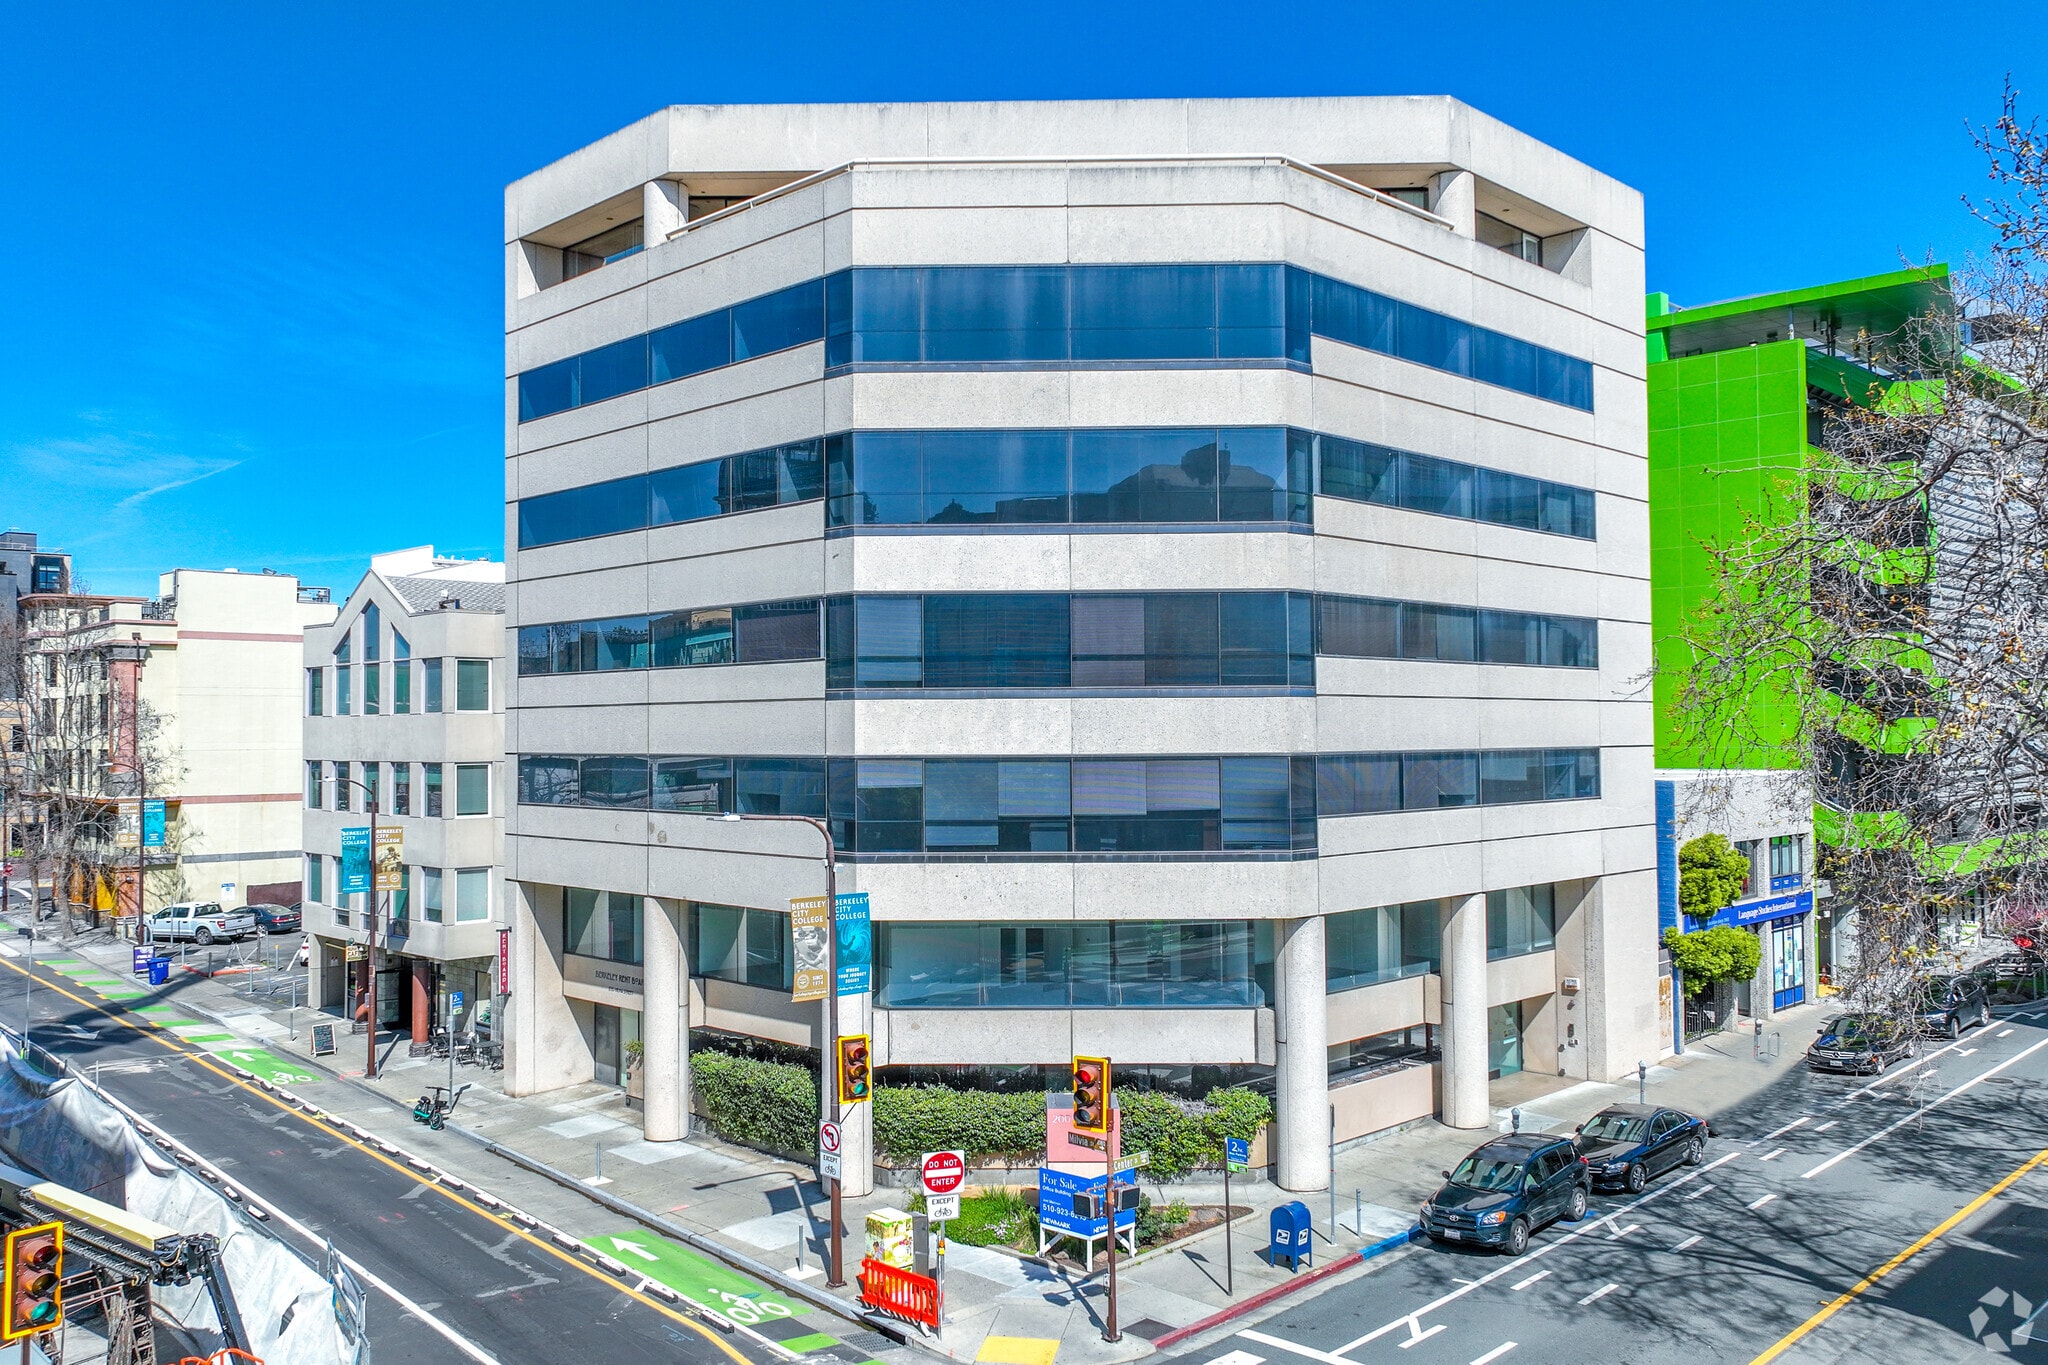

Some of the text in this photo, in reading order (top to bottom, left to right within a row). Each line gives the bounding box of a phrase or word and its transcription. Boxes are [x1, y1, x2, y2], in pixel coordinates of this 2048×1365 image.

[792, 900, 825, 911] BERKELEY
[836, 897, 868, 907] BERKELEY
[792, 910, 809, 918] CITY
[836, 906, 851, 914] CITY
[1738, 907, 1757, 920] Language
[793, 916, 823, 925] COLLEGE
[836, 911, 867, 921] COLLEGE
[1069, 1133, 1088, 1147] Milvia
[1231, 1141, 1238, 1152] 2
[823, 1154, 838, 1164] EXCEPT
[943, 1159, 958, 1167] NOT
[1114, 1159, 1133, 1171] Center
[931, 1178, 955, 1186] ENTER
[1042, 1173, 1077, 1189] For Sale
[1055, 1189, 1072, 1197] Building
[931, 1196, 954, 1205] EXCEPT
[1043, 1217, 1071, 1229] NEWMARK
